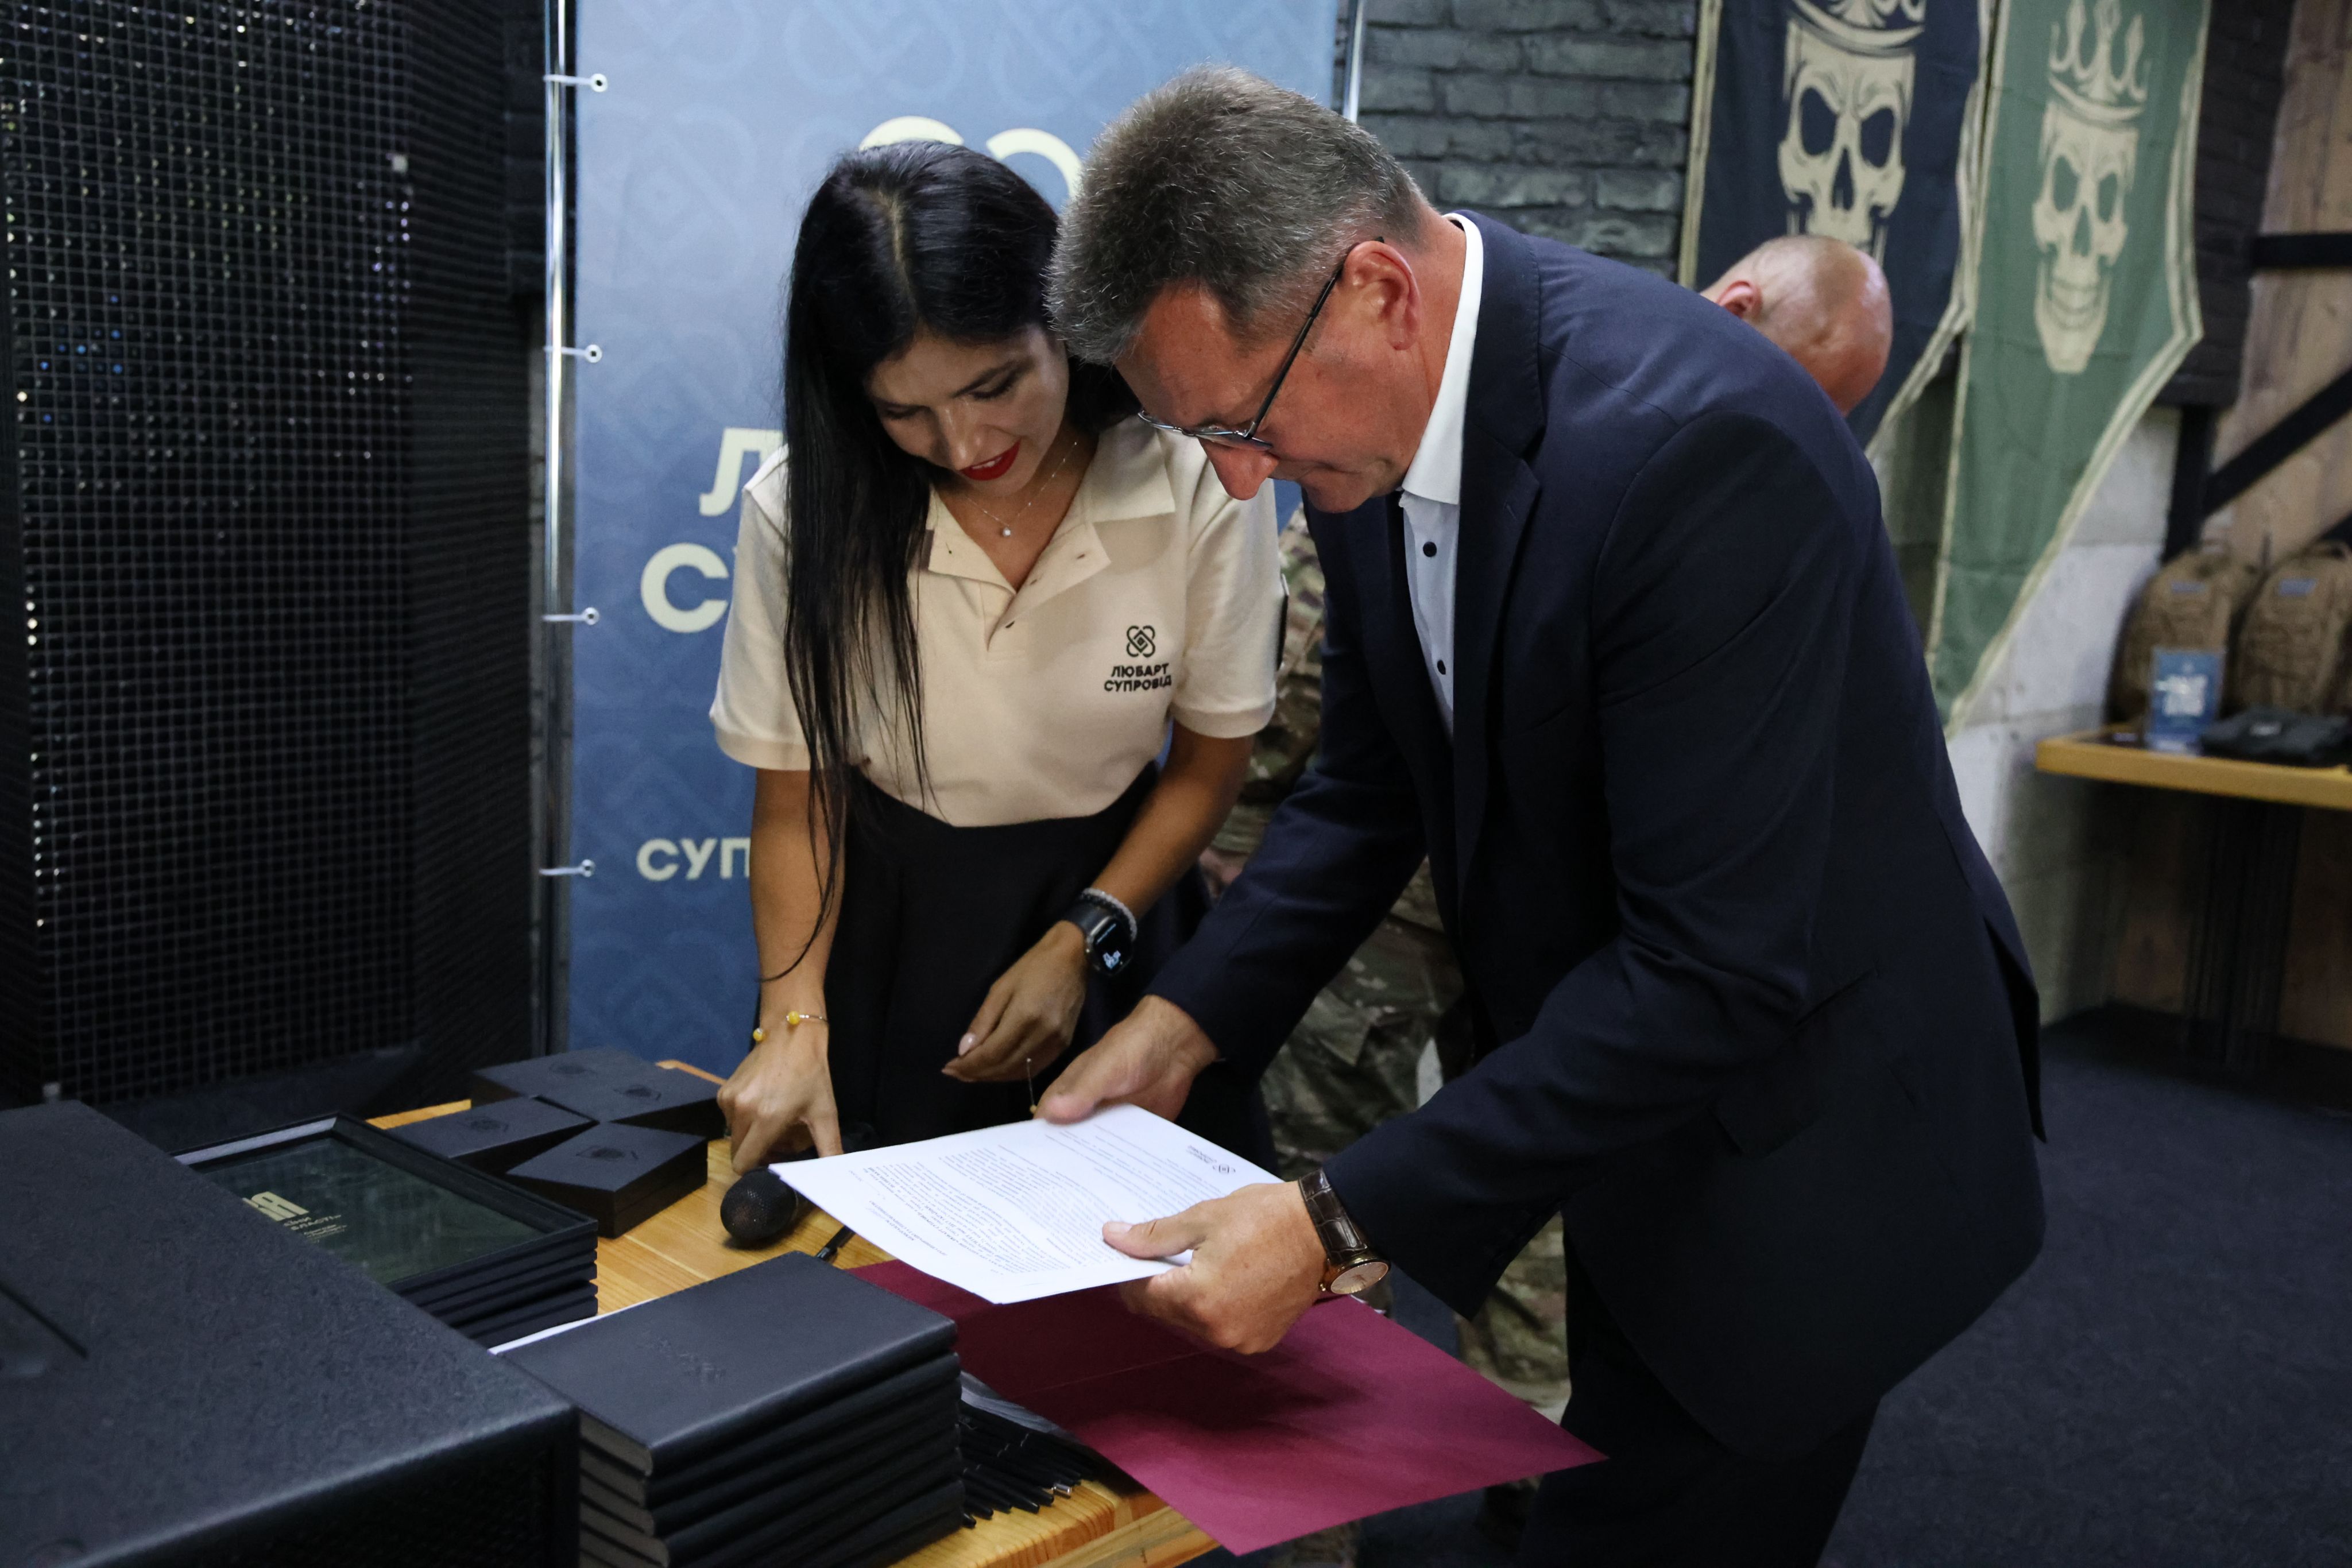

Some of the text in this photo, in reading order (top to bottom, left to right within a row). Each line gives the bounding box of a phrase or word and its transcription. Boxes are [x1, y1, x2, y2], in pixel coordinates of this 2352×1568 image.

[1111, 663, 1170, 678] ЛЮБАРТ
[1104, 675, 1172, 692] СУПРОВІД
[636, 837, 751, 881] СУП
